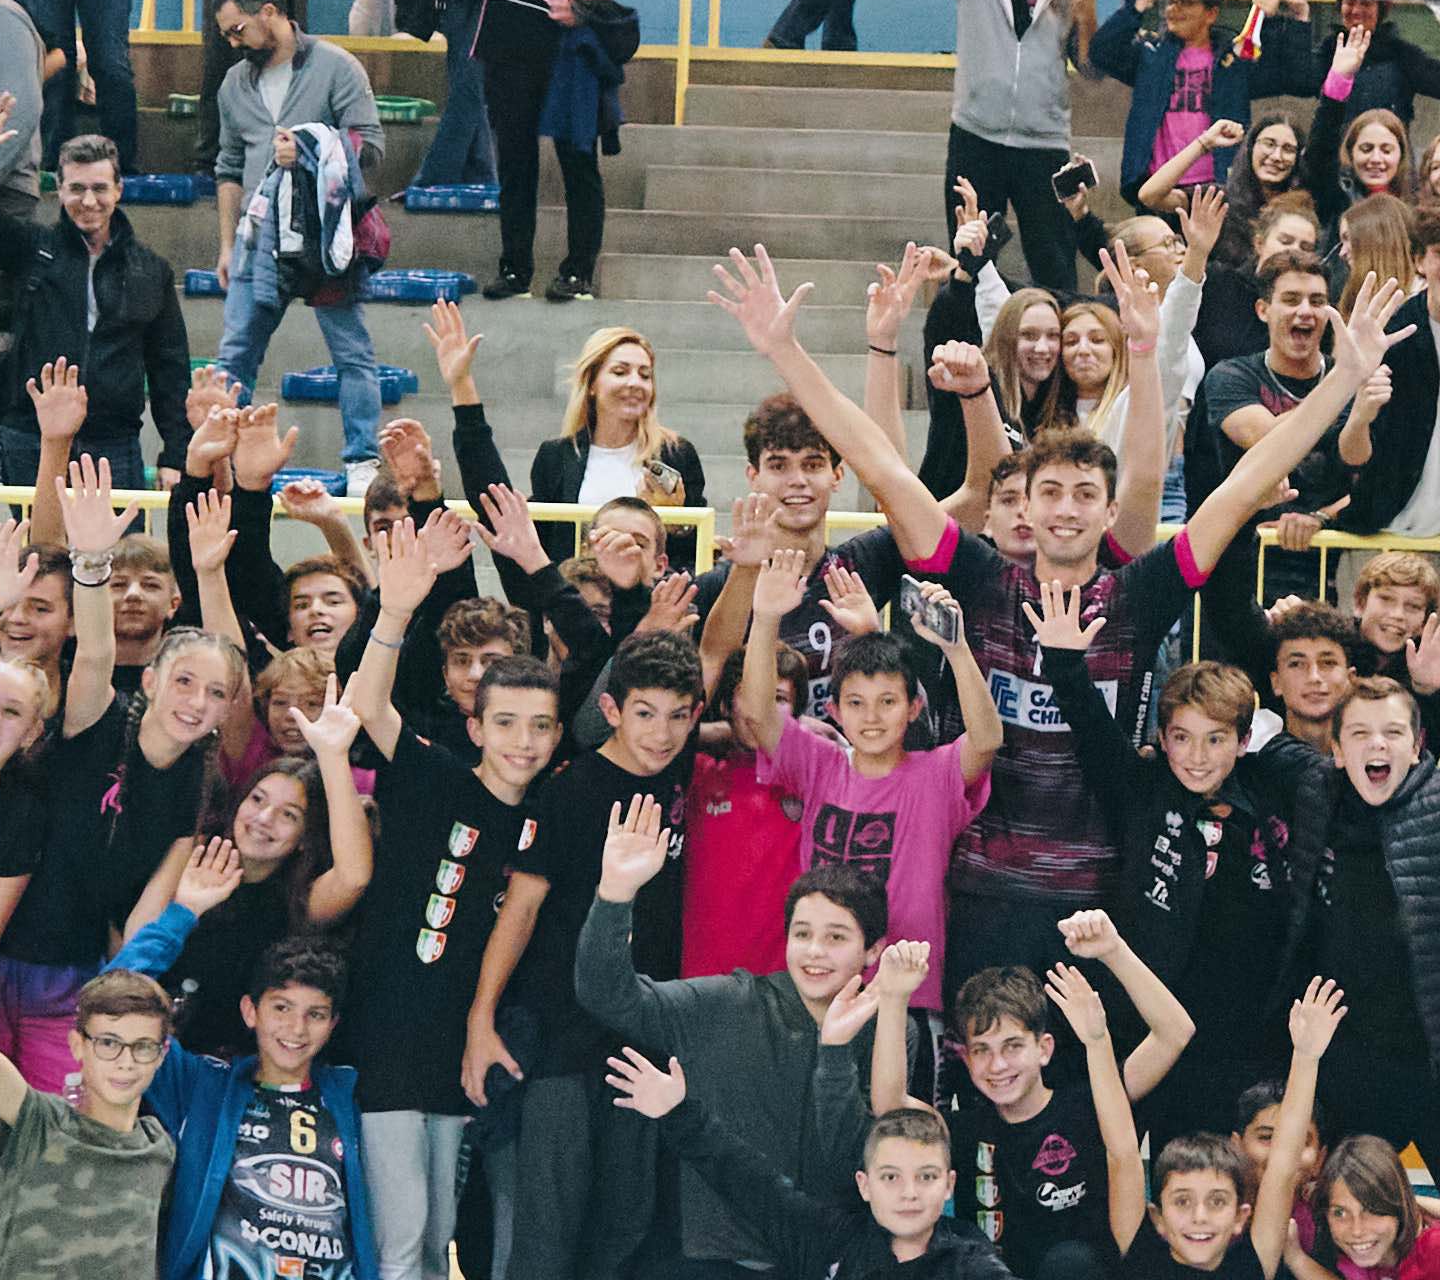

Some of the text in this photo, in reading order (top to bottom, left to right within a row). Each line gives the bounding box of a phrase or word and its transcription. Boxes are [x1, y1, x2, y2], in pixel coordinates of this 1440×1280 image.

[808, 621, 832, 671] 9
[290, 1109, 318, 1154] 6
[269, 1163, 327, 1205] SIR
[259, 1207, 294, 1227] Safety
[261, 1226, 345, 1261] CONAD
